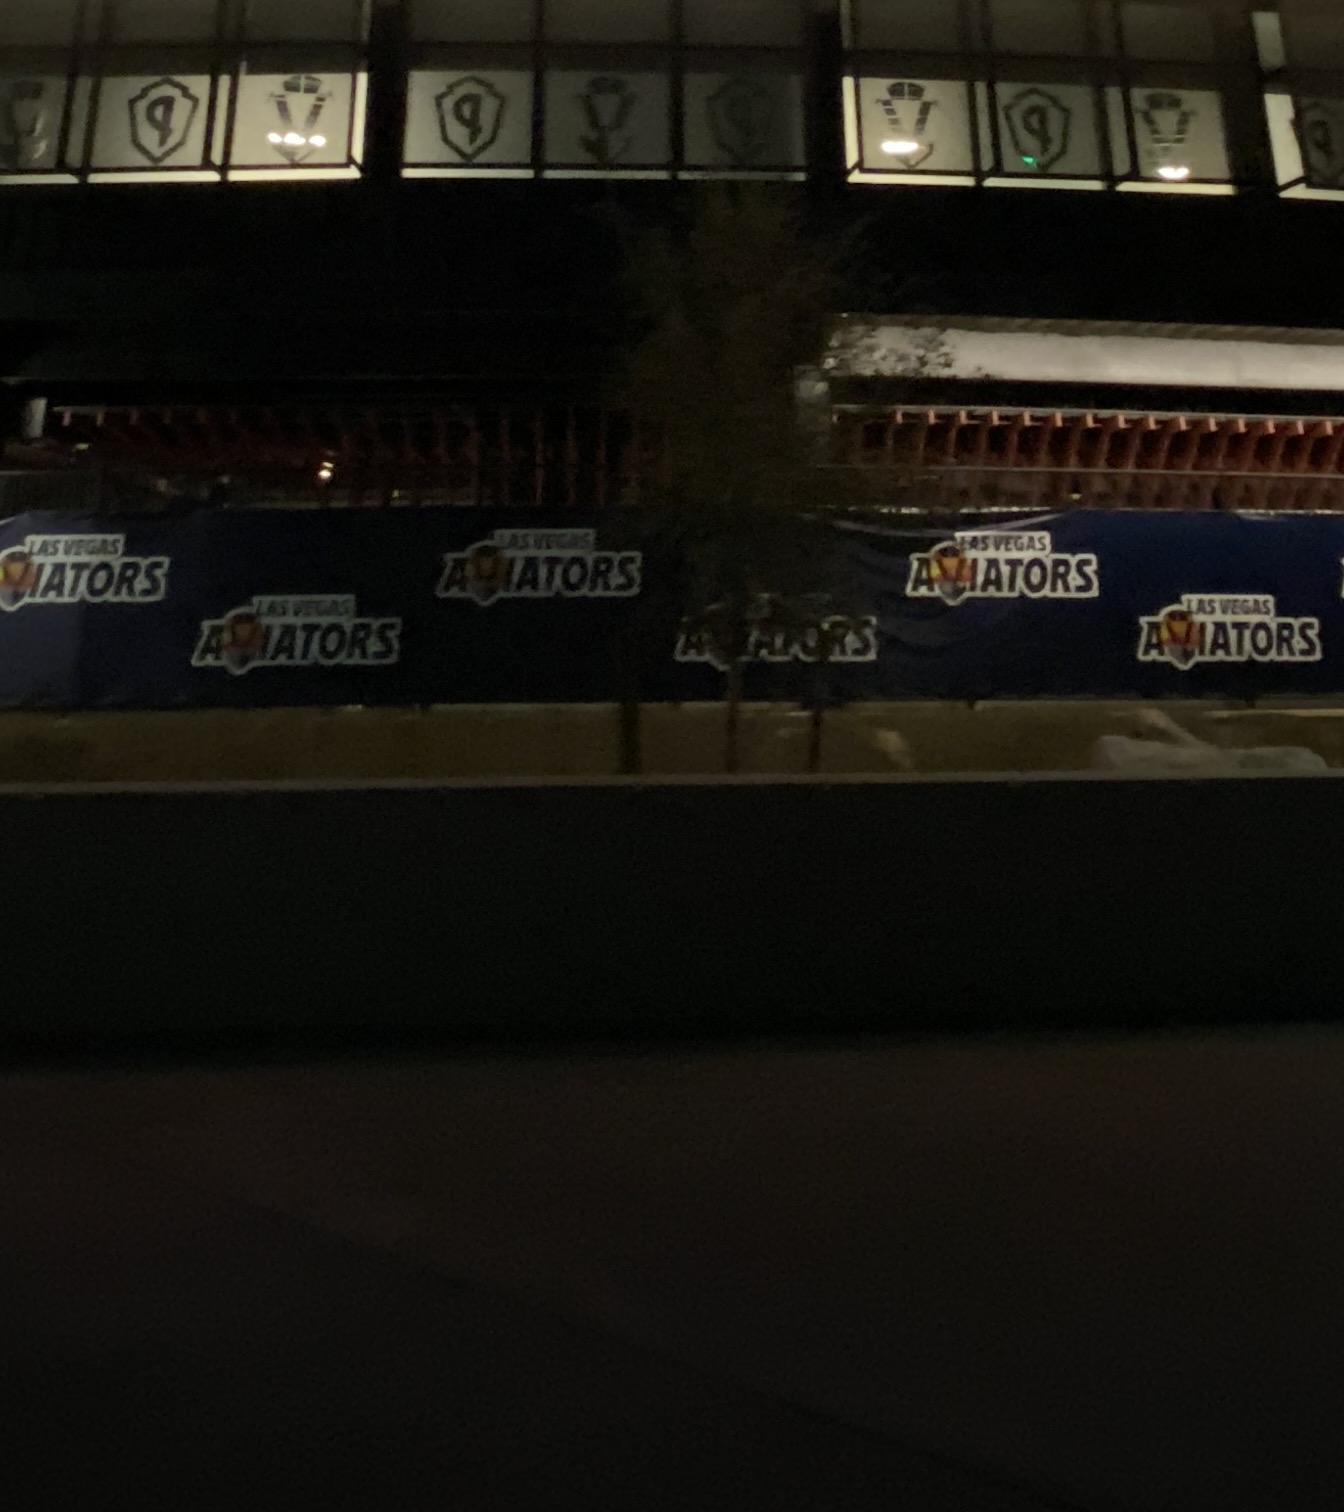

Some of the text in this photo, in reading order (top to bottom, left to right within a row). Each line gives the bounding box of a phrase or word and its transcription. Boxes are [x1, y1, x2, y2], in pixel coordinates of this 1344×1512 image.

[960, 536, 1047, 552] LAS VEGAS
[1187, 599, 1272, 615] LAS VEGAS
